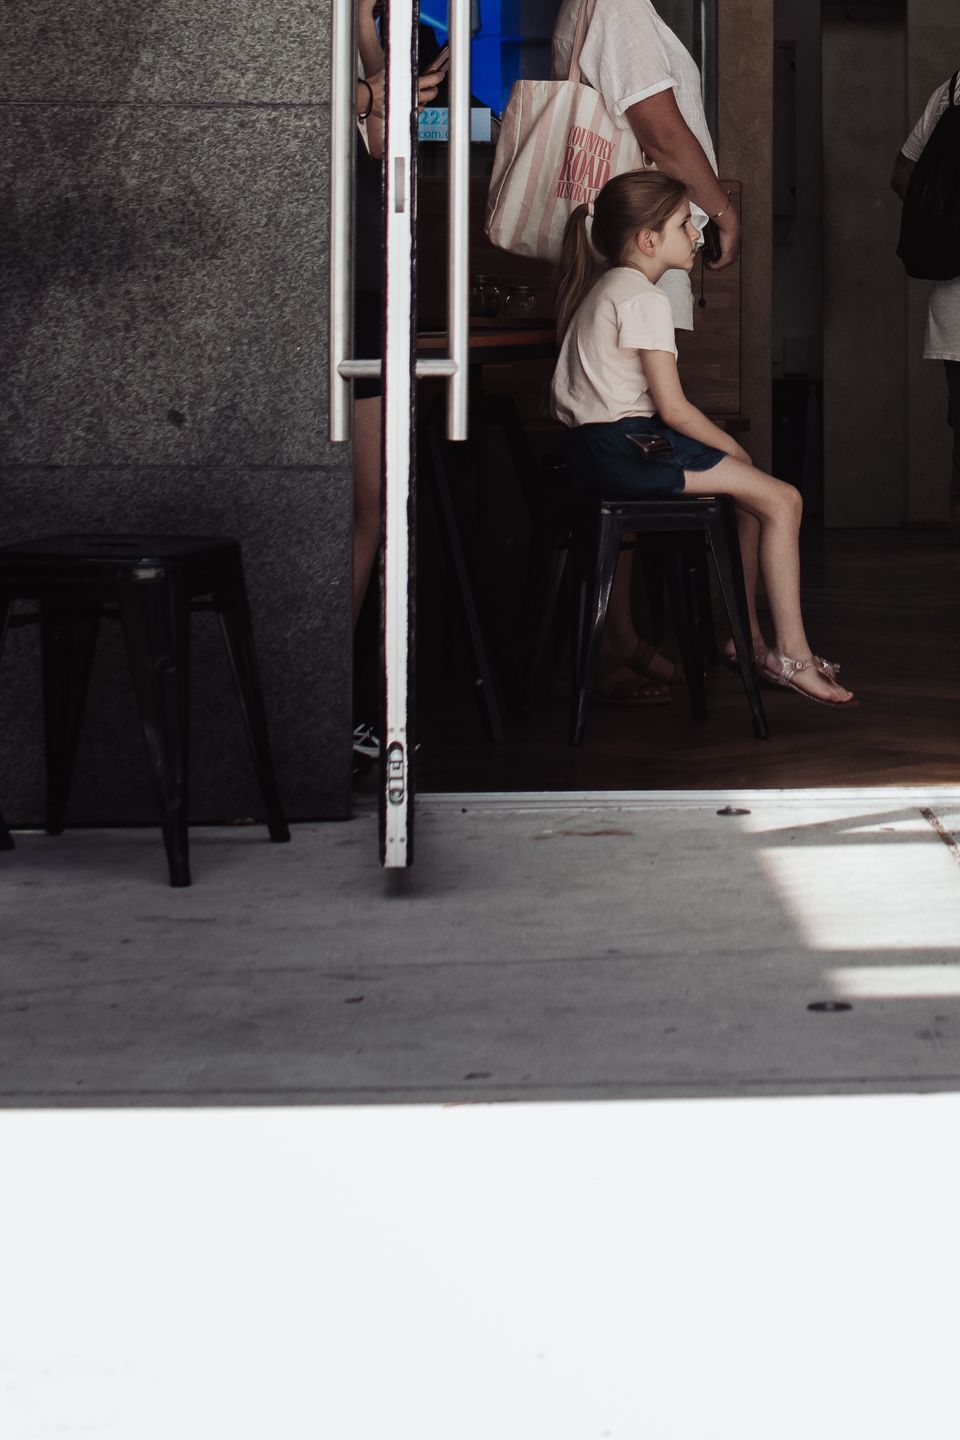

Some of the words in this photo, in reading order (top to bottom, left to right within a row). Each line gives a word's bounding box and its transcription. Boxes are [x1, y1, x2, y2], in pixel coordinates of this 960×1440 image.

[567, 125, 615, 161] COUNTRY
[559, 146, 612, 190] ROAD
[553, 181, 601, 204] AUSTRALI
